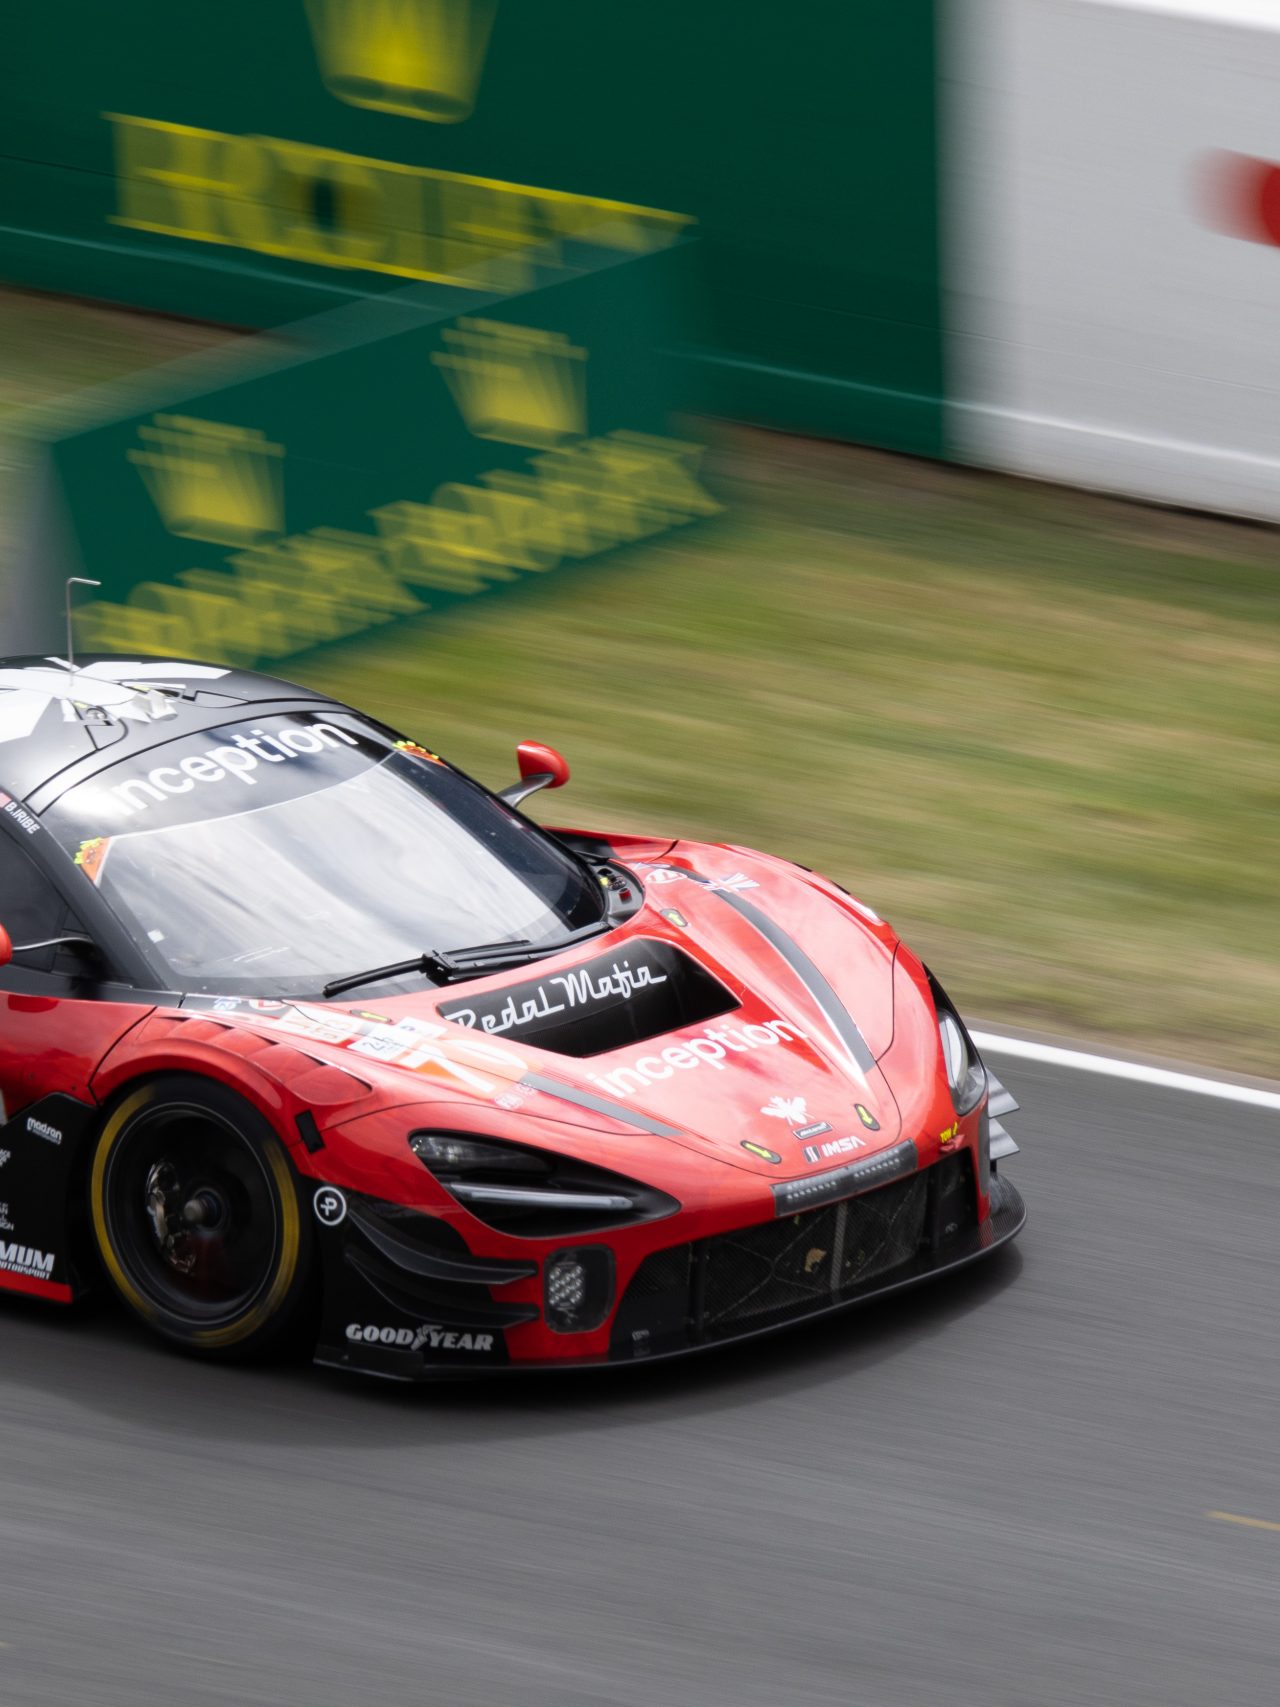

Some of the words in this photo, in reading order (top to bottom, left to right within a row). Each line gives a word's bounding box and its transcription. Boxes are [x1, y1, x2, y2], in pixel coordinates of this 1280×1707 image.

[106, 722, 359, 816] nception
[4, 802, 40, 835] B.IRIBE
[549, 960, 668, 1008] Mafia
[397, 1038, 529, 1093] 70
[585, 1018, 809, 1099] inception
[821, 1135, 867, 1157] IMSA
[346, 1323, 494, 1351] GOODYEAR
